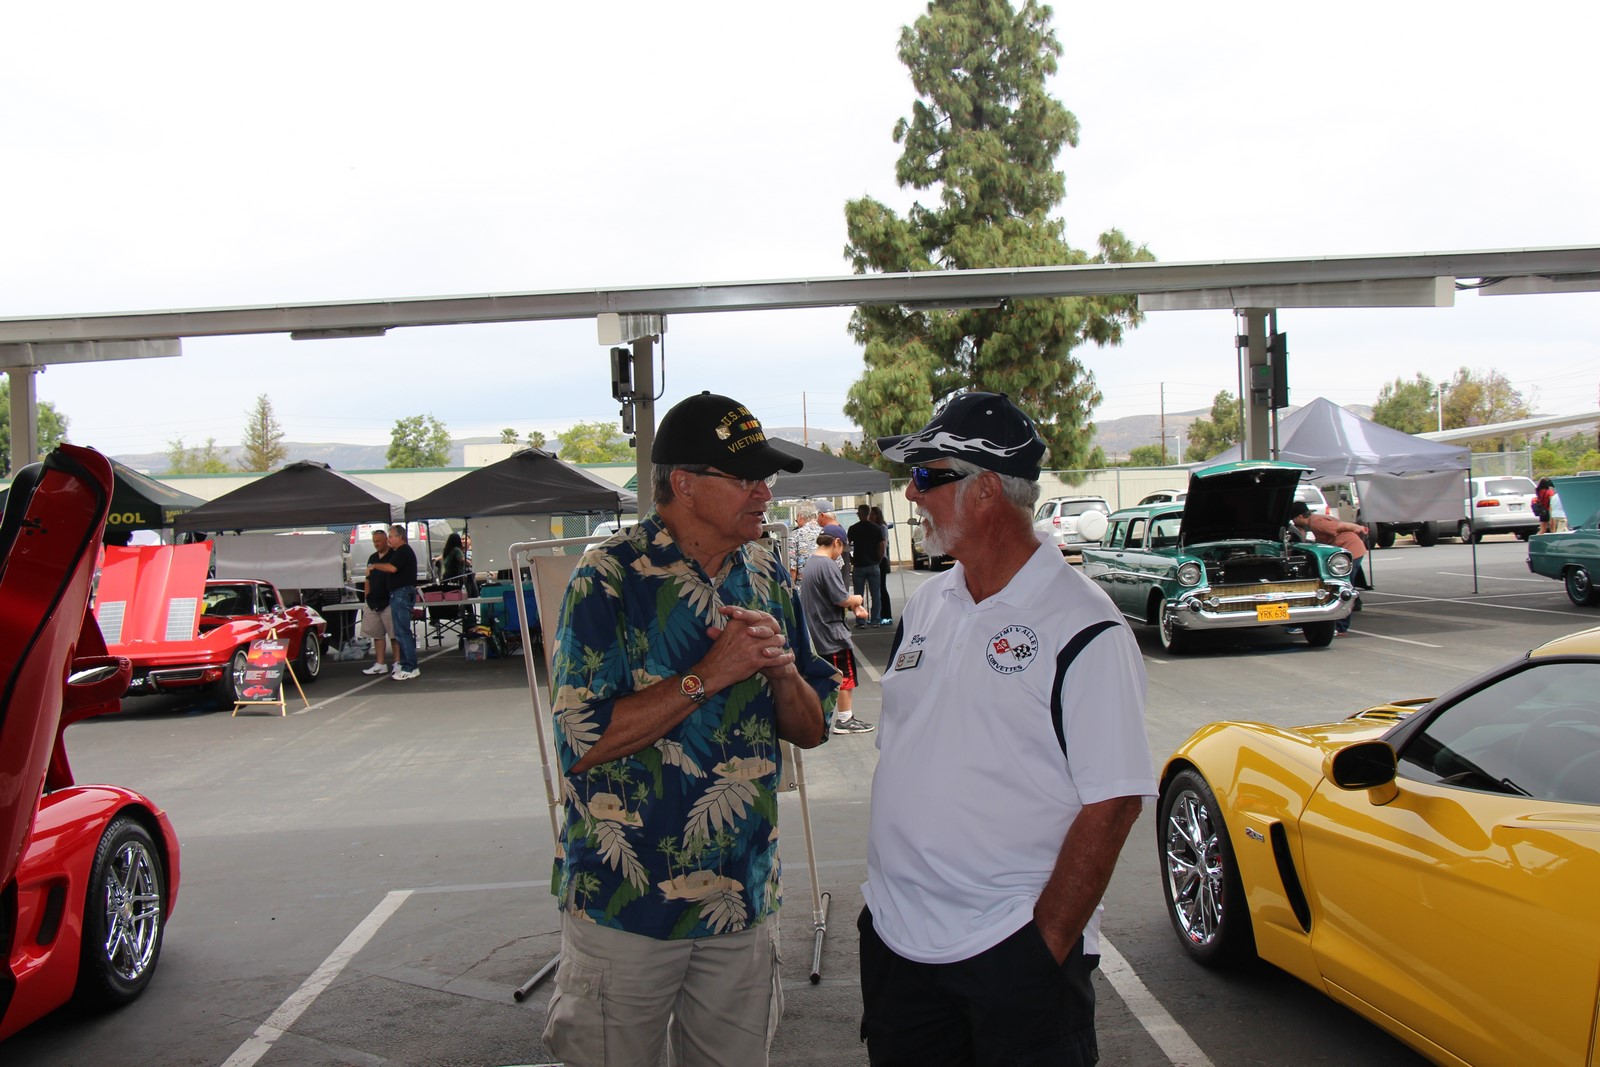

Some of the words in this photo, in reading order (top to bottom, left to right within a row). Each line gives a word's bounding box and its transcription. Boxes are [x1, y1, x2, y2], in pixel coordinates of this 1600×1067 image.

[720, 411, 740, 427] U.S.
[727, 432, 765, 453] VIETNAM
[106, 512, 146, 525] OOL
[1259, 610, 1274, 619] YRK
[1274, 609, 1287, 618] 638
[994, 627, 1013, 640] SIMI
[1015, 627, 1037, 651] VALLEY
[988, 653, 1023, 672] CORVETTES
